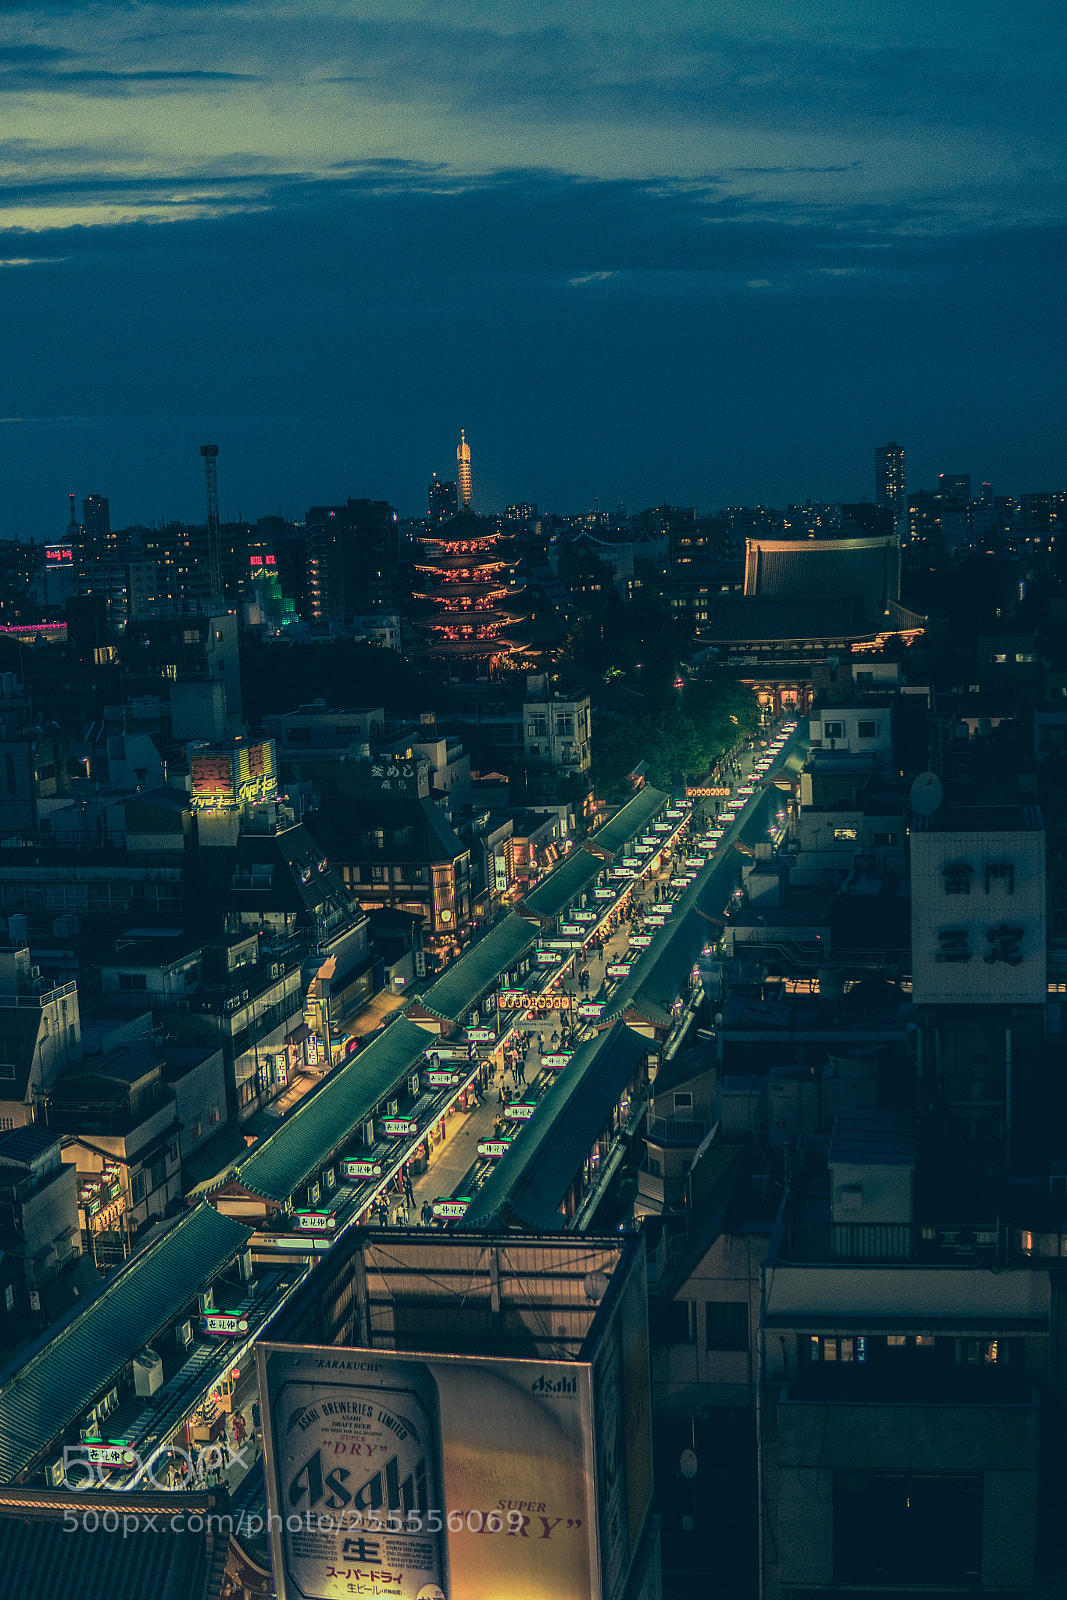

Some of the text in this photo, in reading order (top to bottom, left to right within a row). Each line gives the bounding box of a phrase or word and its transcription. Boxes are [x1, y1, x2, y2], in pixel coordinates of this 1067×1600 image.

[371, 765, 414, 778] 釜めし
[315, 1359, 383, 1372] "KARAKUCHI"
[531, 1375, 577, 1394] Asahi
[299, 1402, 408, 1441] ASAHI BREWERIES LIMITED
[340, 1434, 367, 1442] SUPER
[288, 1448, 428, 1518] Asahi
[496, 1500, 547, 1513] SUPER
[342, 1537, 383, 1565] 生
[326, 1566, 403, 1585] スーパードライ
[346, 1583, 381, 1596] 生ビール
